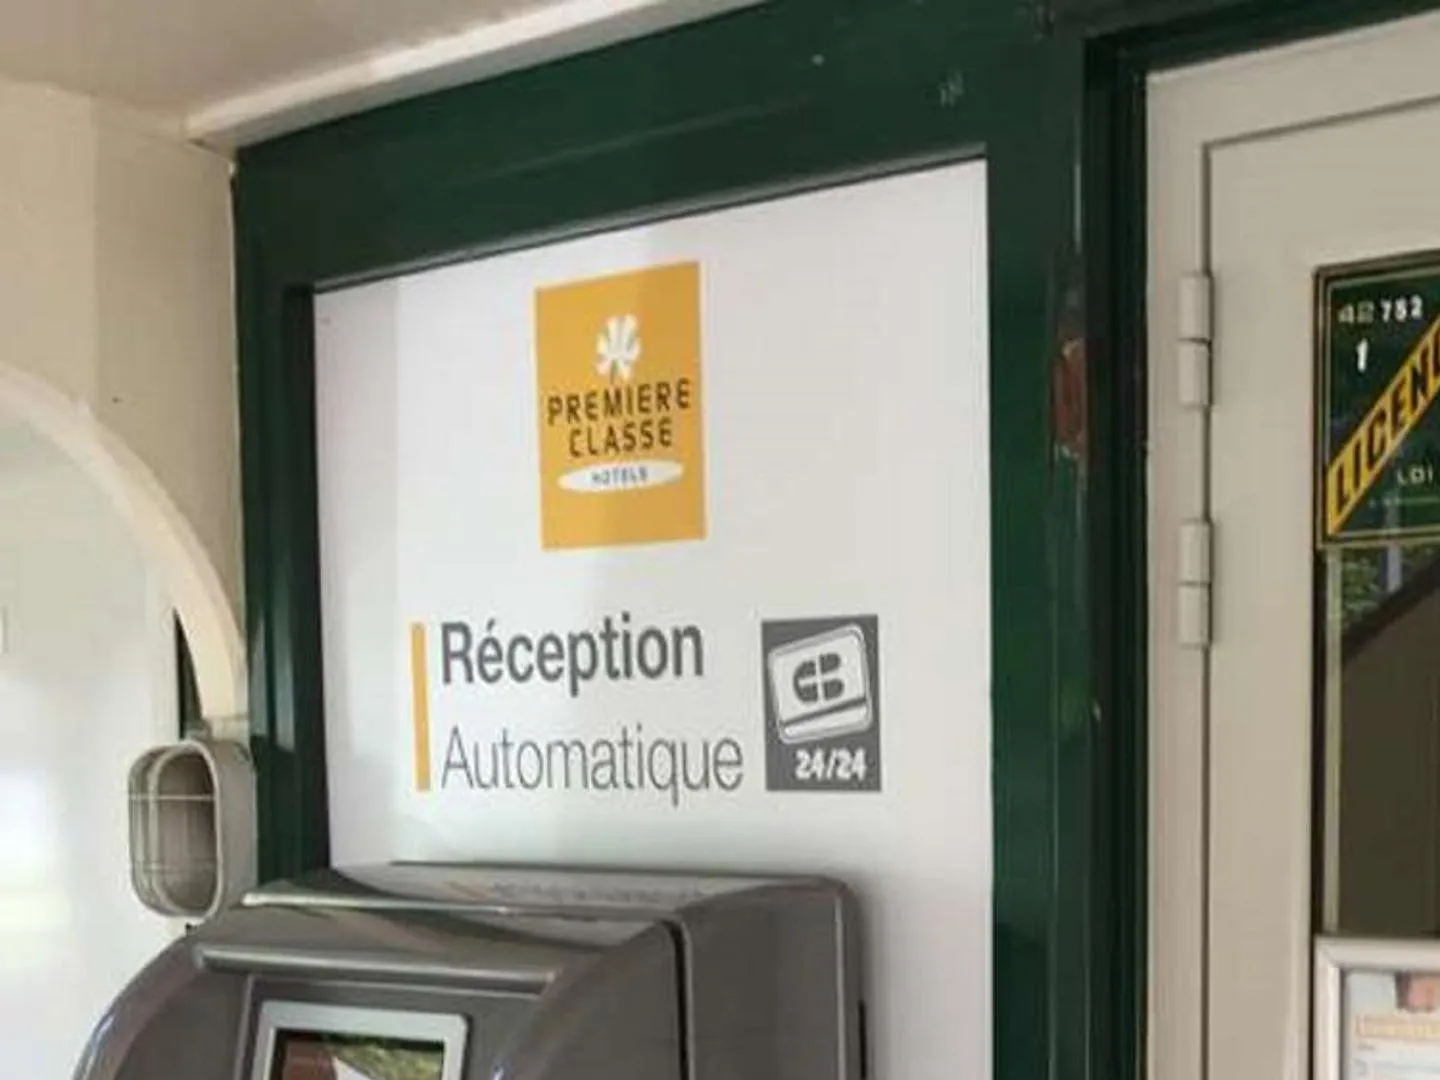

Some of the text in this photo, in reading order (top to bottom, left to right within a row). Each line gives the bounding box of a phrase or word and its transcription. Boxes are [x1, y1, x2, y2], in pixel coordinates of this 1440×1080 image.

[547, 378, 692, 425] PREMIERE
[568, 416, 673, 458] CLASSE
[591, 466, 649, 486] HOTELS
[441, 611, 705, 698] Réception
[792, 652, 845, 703] CB
[441, 725, 745, 807] Automatique
[794, 747, 868, 781] 24/24
